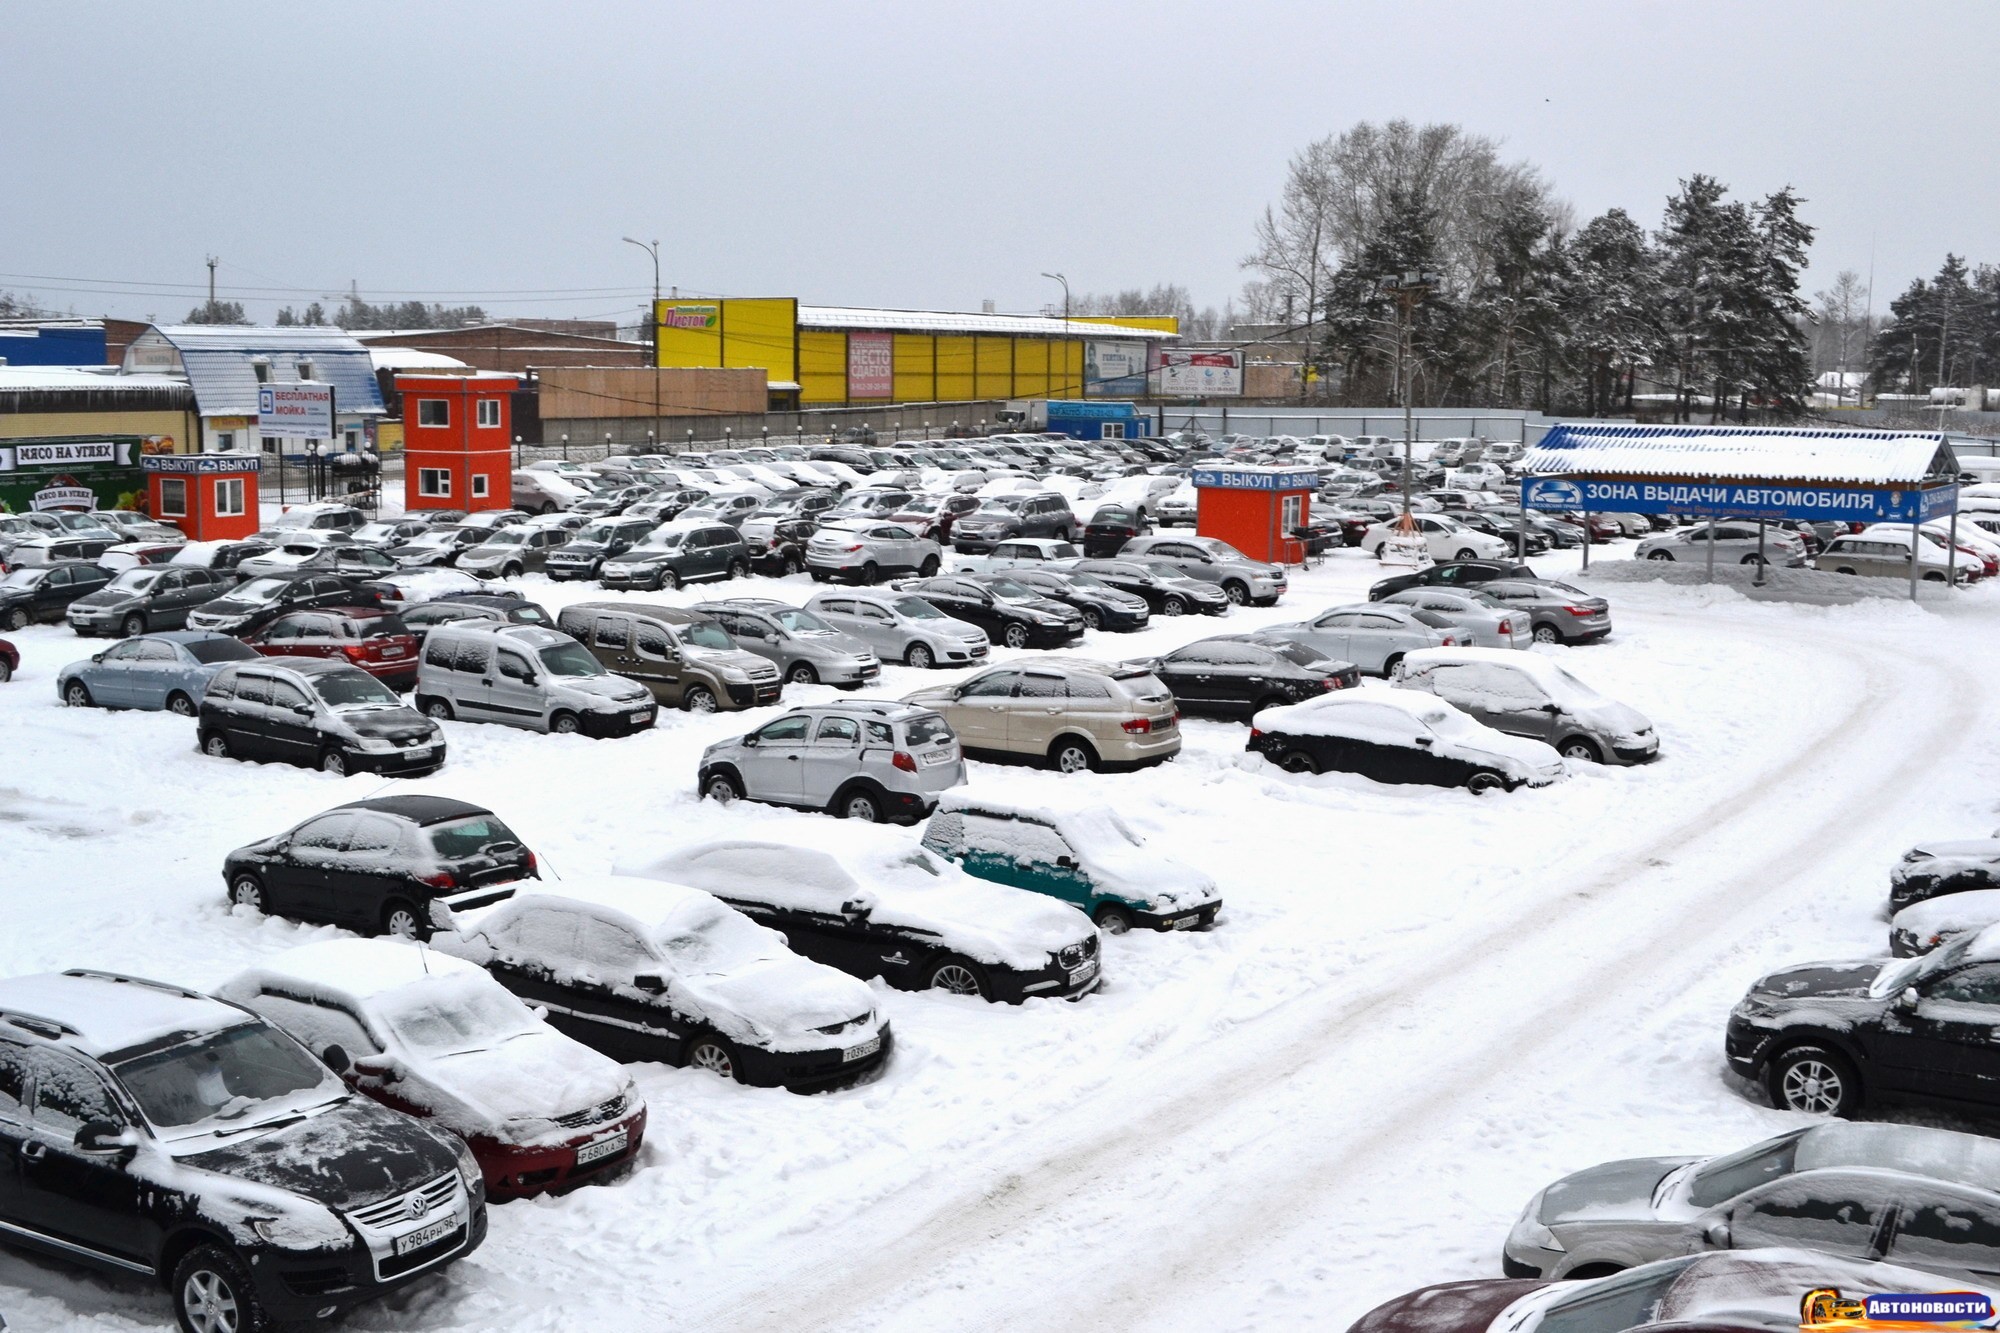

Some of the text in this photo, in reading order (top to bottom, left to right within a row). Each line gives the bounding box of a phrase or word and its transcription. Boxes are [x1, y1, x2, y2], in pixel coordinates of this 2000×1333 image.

[664, 307, 706, 327] Листок
[850, 349, 891, 365] МЕСТО
[850, 365, 891, 379] СДАЕТСЯ
[274, 391, 330, 401] БЕСПЛАТНАЯ
[274, 404, 307, 416] МОЙКА
[20, 445, 112, 460] МЯСО НА УГЛЯХ
[160, 460, 196, 472] ВЫКУП
[219, 459, 258, 471] ВЫКУП
[1222, 473, 1273, 488] ВЫКУП
[1292, 473, 1319, 488] ВЫКУП
[37, 490, 91, 501] МЯСО НА УГЛЯХ
[1586, 483, 1875, 510] ЗОНА ВЫДАЧИ АВТОМОБИЛЯ
[401, 1217, 454, 1253] У984РН 96
